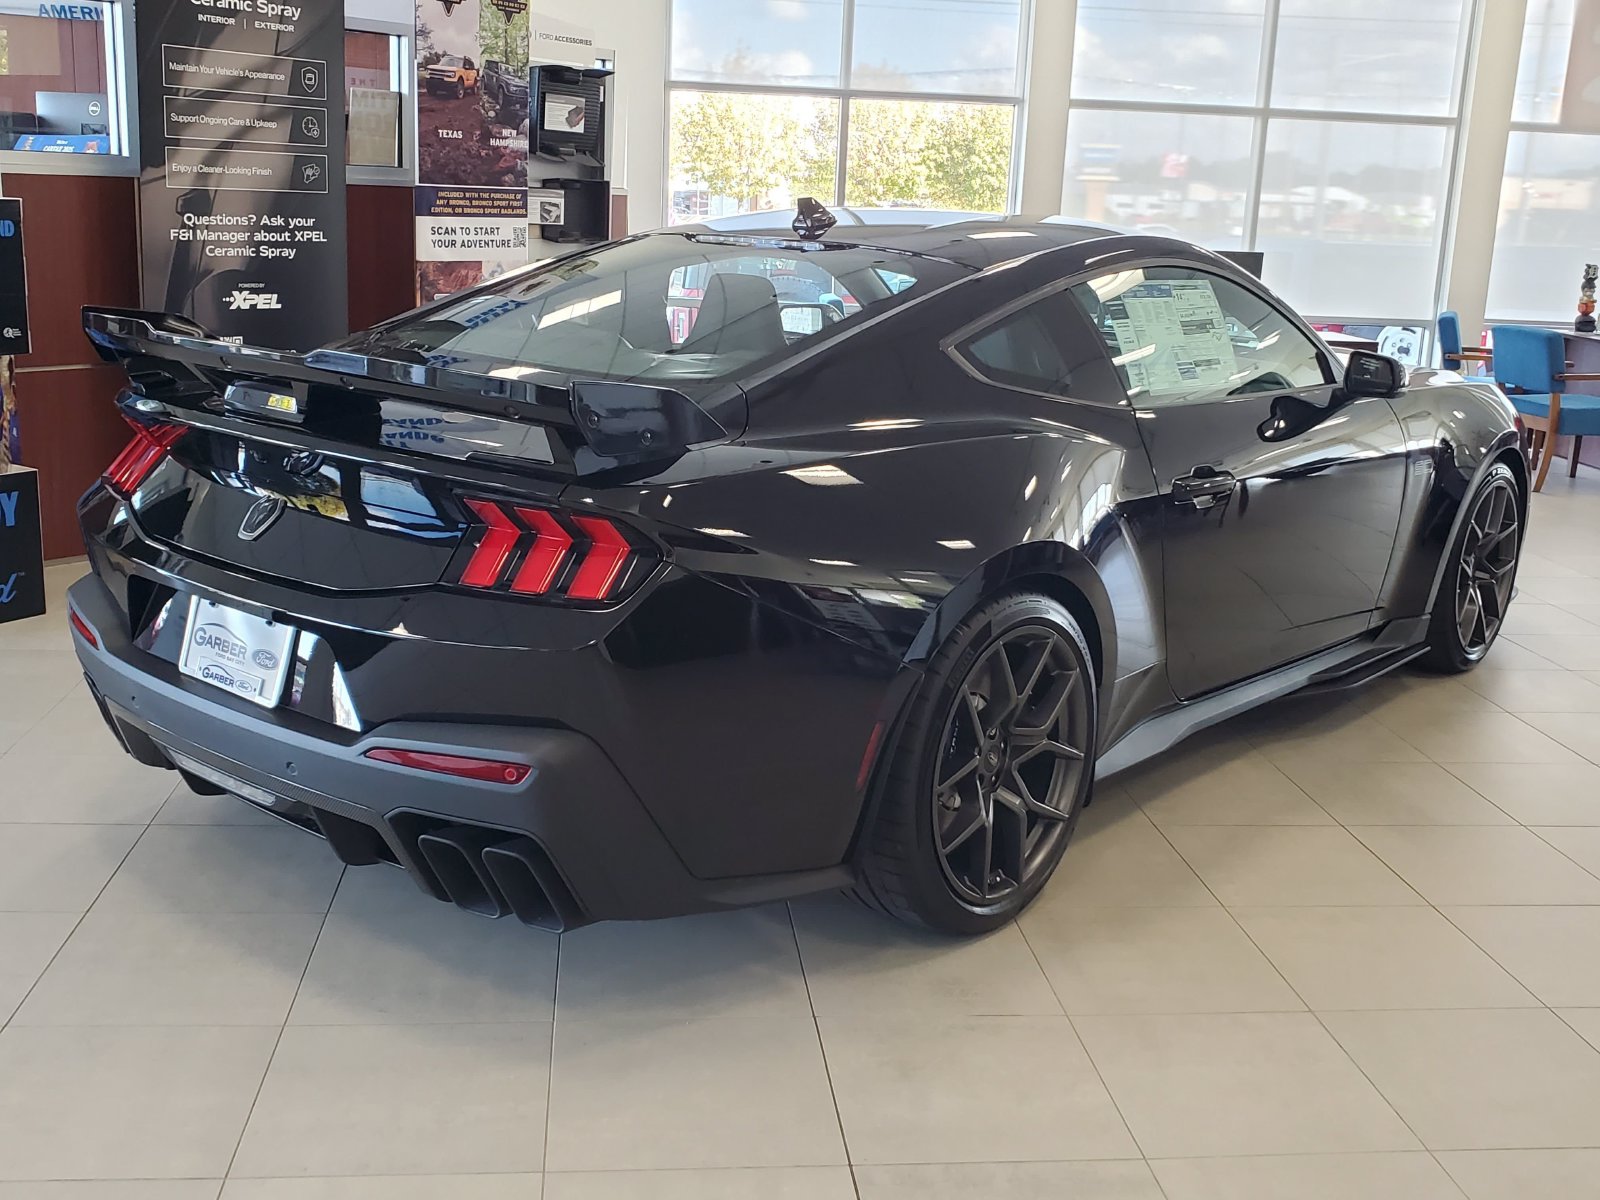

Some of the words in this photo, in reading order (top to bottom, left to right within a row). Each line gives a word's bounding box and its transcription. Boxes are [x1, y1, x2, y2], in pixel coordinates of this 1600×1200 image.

[39, 3, 104, 20] AMERI
[256, 0, 301, 21] Spray
[198, 14, 235, 25] INTERIOR
[255, 21, 294, 32] EXTERIOR
[554, 34, 593, 47] ACCESSORIES
[169, 62, 199, 73] Maintain
[199, 64, 215, 75] Your
[214, 65, 244, 78] Vehicle's
[244, 69, 286, 82] Appearance
[170, 112, 200, 124] Support
[200, 114, 228, 127] Ongoing
[228, 116, 245, 126] Care
[245, 118, 252, 127] &
[251, 118, 278, 130] Upkeep
[438, 129, 463, 139] TEXAS
[502, 129, 517, 138] NEW
[172, 163, 192, 175] Enjoy
[192, 165, 198, 173] a
[197, 164, 252, 177] Cleaner-Looking
[252, 167, 273, 177] Finish
[183, 213, 257, 228] Questions?
[259, 214, 286, 227] Ask
[288, 216, 316, 229] your
[169, 228, 194, 241] F&I
[196, 229, 251, 244] Manager
[253, 230, 292, 242] about
[294, 231, 328, 242] XPEL
[430, 226, 457, 236] SCAN
[459, 227, 471, 236] TO
[473, 227, 501, 236] START
[431, 239, 457, 248] YOUR
[460, 239, 512, 248] ADVENTURE
[205, 245, 257, 257] Ceramic
[259, 245, 297, 260] Spray
[229, 290, 282, 310] XPEL
[194, 627, 248, 660] GARBER
[256, 651, 275, 668] Ford
[202, 667, 235, 688] GARBER
